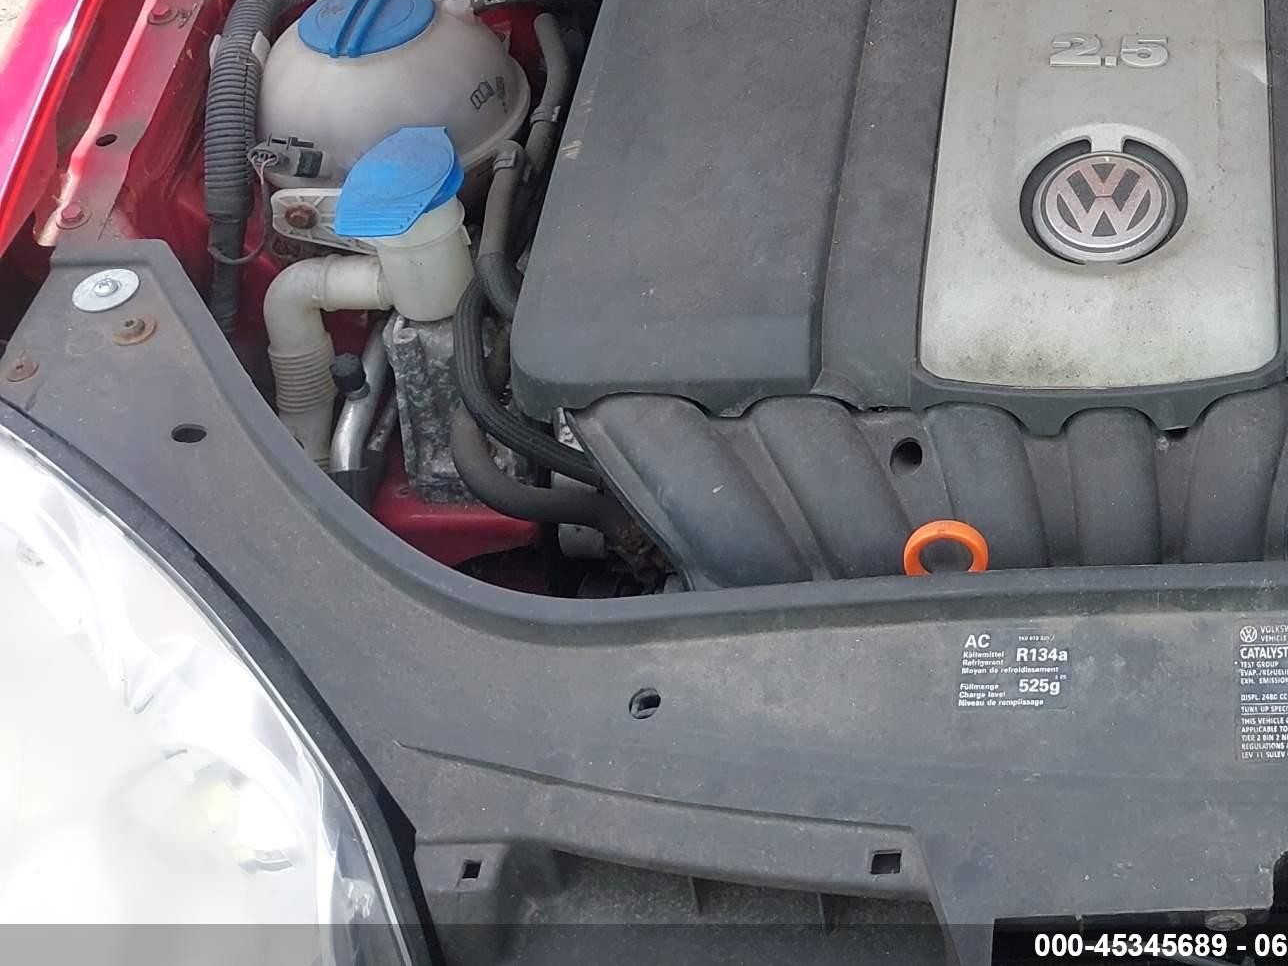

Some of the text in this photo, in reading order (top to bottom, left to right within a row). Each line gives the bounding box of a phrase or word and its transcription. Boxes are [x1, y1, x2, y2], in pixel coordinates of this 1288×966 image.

[1050, 34, 1168, 68] 2.5
[964, 634, 990, 648] AC
[1260, 634, 1286, 642] VEHICLE
[963, 650, 1004, 658] Kältemittel
[1016, 648, 1068, 662] R134a
[1240, 646, 1288, 659] CATALYST
[962, 659, 1004, 667] Refrigerant
[989, 666, 998, 674] de
[1001, 666, 1059, 674] refroidissement
[1019, 678, 1060, 696] 525g
[959, 691, 986, 700] Charge
[998, 698, 1044, 707] remplissage
[1258, 716, 1284, 724] VEHICLE
[1242, 742, 1284, 750] REGULATIONS
